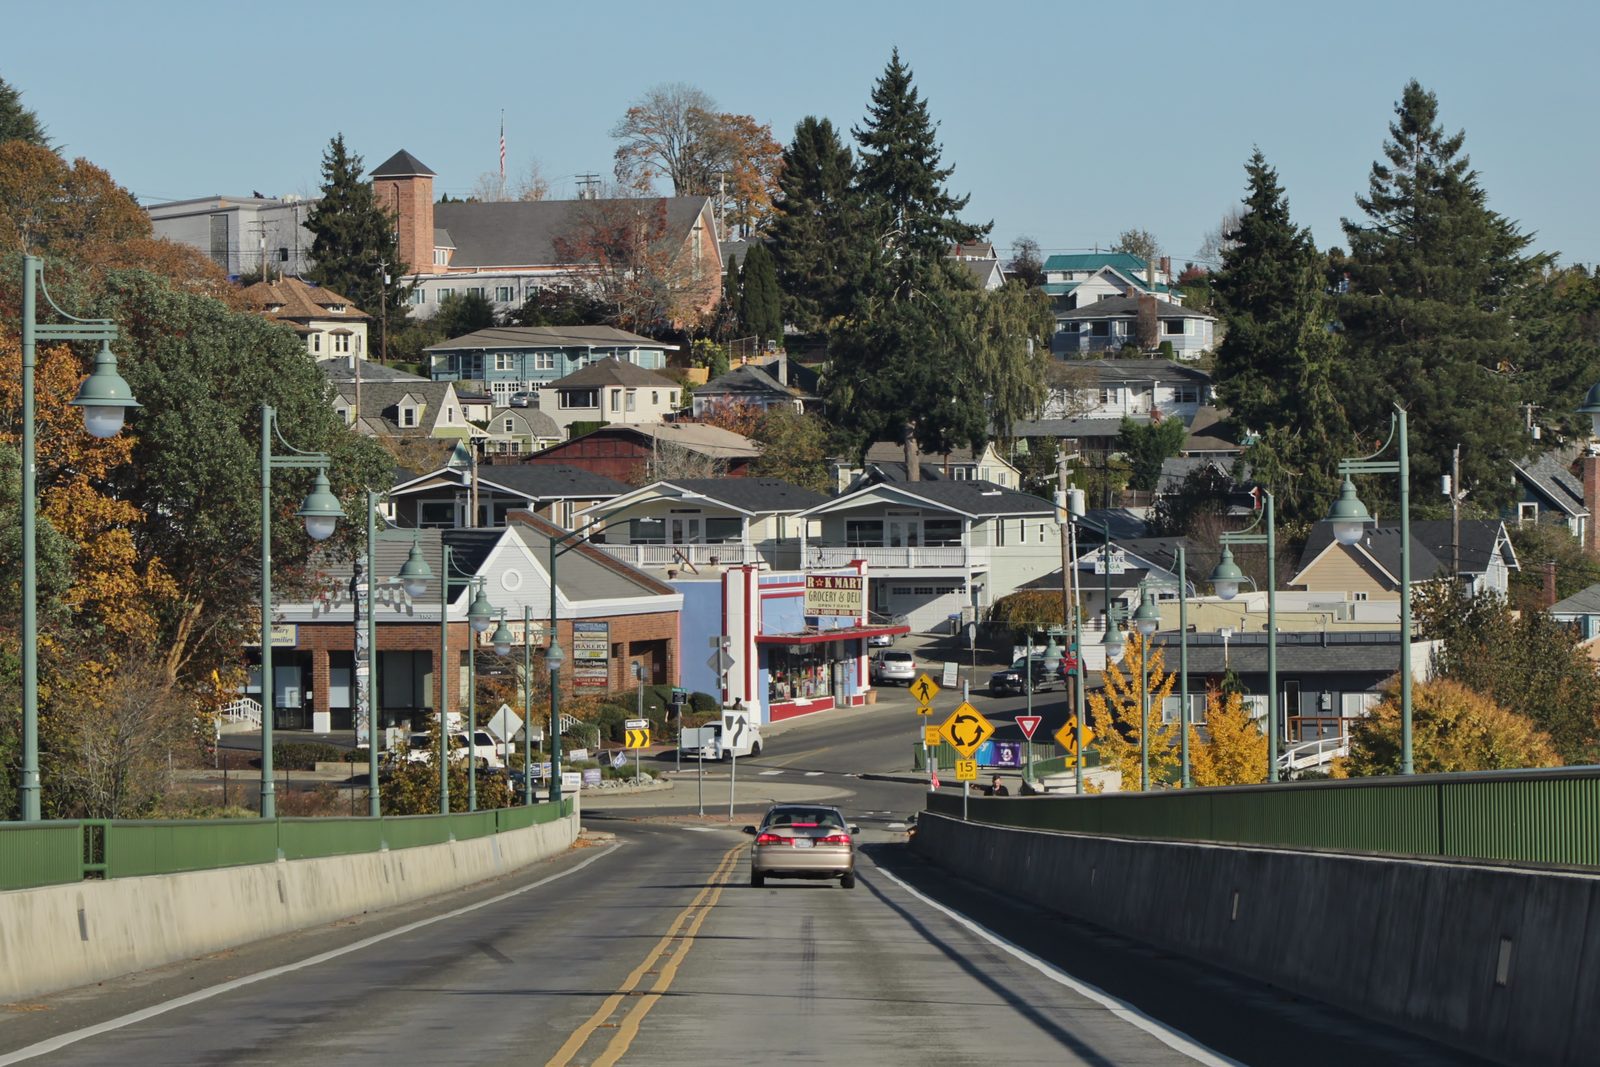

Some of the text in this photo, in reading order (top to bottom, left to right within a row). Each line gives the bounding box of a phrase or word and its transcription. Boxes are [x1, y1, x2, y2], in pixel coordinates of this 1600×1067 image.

[834, 577, 862, 588] MART
[808, 590, 860, 604] GROCERY & DELI
[959, 762, 974, 773] 15
